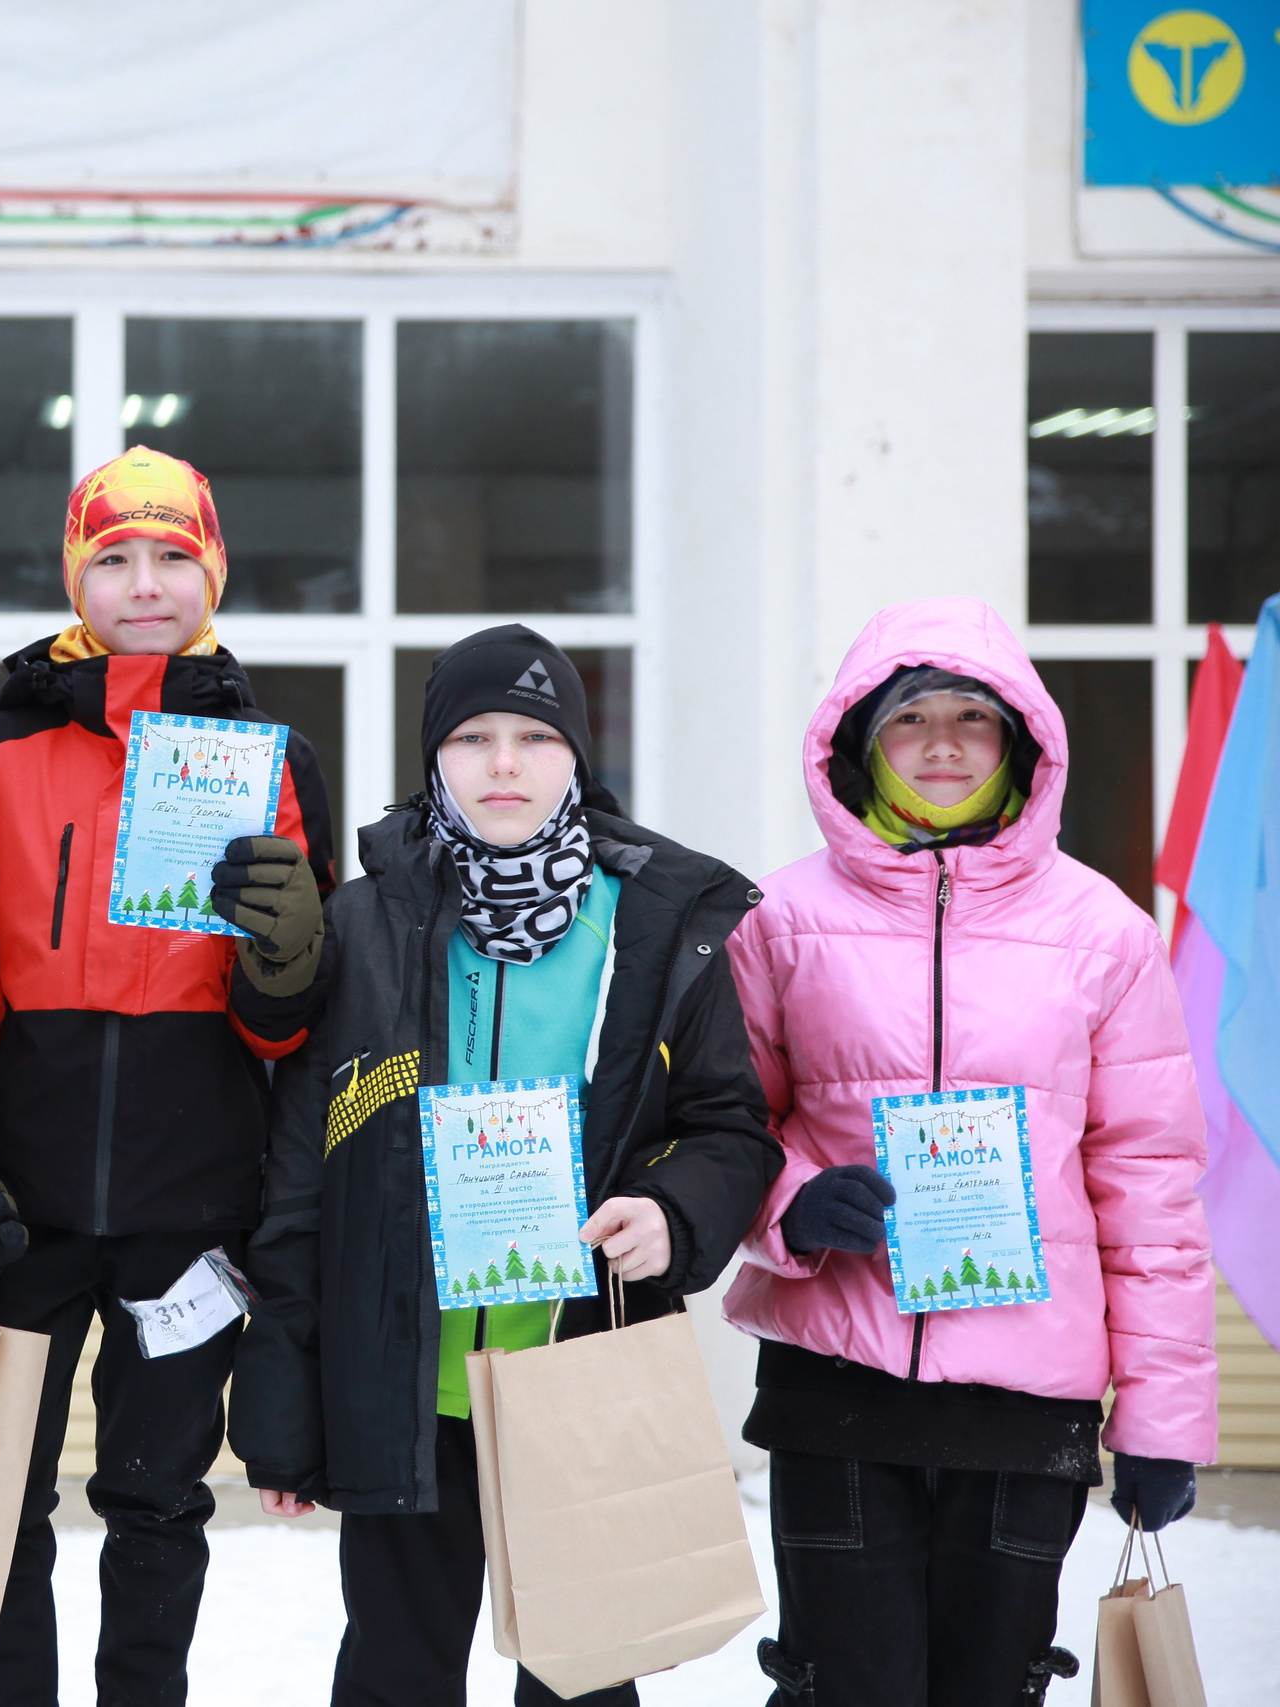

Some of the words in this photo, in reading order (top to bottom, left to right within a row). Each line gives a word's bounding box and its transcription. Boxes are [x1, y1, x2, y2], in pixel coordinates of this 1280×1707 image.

[100, 510, 187, 530] FISCHER
[506, 688, 560, 709] FISCHER
[153, 772, 251, 796] ГРАМОТА
[176, 795, 225, 805] Награждается
[200, 822, 223, 830] МЕСТО
[154, 830, 190, 838] городских
[147, 836, 193, 847] спортивному
[174, 858, 197, 866] группе
[465, 987, 479, 1066] FISCHER
[452, 1137, 551, 1160] ГРАМОТА
[904, 1146, 1001, 1169] ГРАМОТА
[479, 1159, 529, 1170] Награждается
[932, 1169, 980, 1179] Награждается
[465, 1200, 501, 1209] городских
[503, 1195, 557, 1206] соревнованиях
[460, 1208, 506, 1218] спортивному
[919, 1208, 954, 1217] городских
[956, 1204, 1008, 1214] соревнованиях
[914, 1216, 959, 1226] спортивному
[491, 1228, 515, 1237] группе
[945, 1236, 968, 1244] группе
